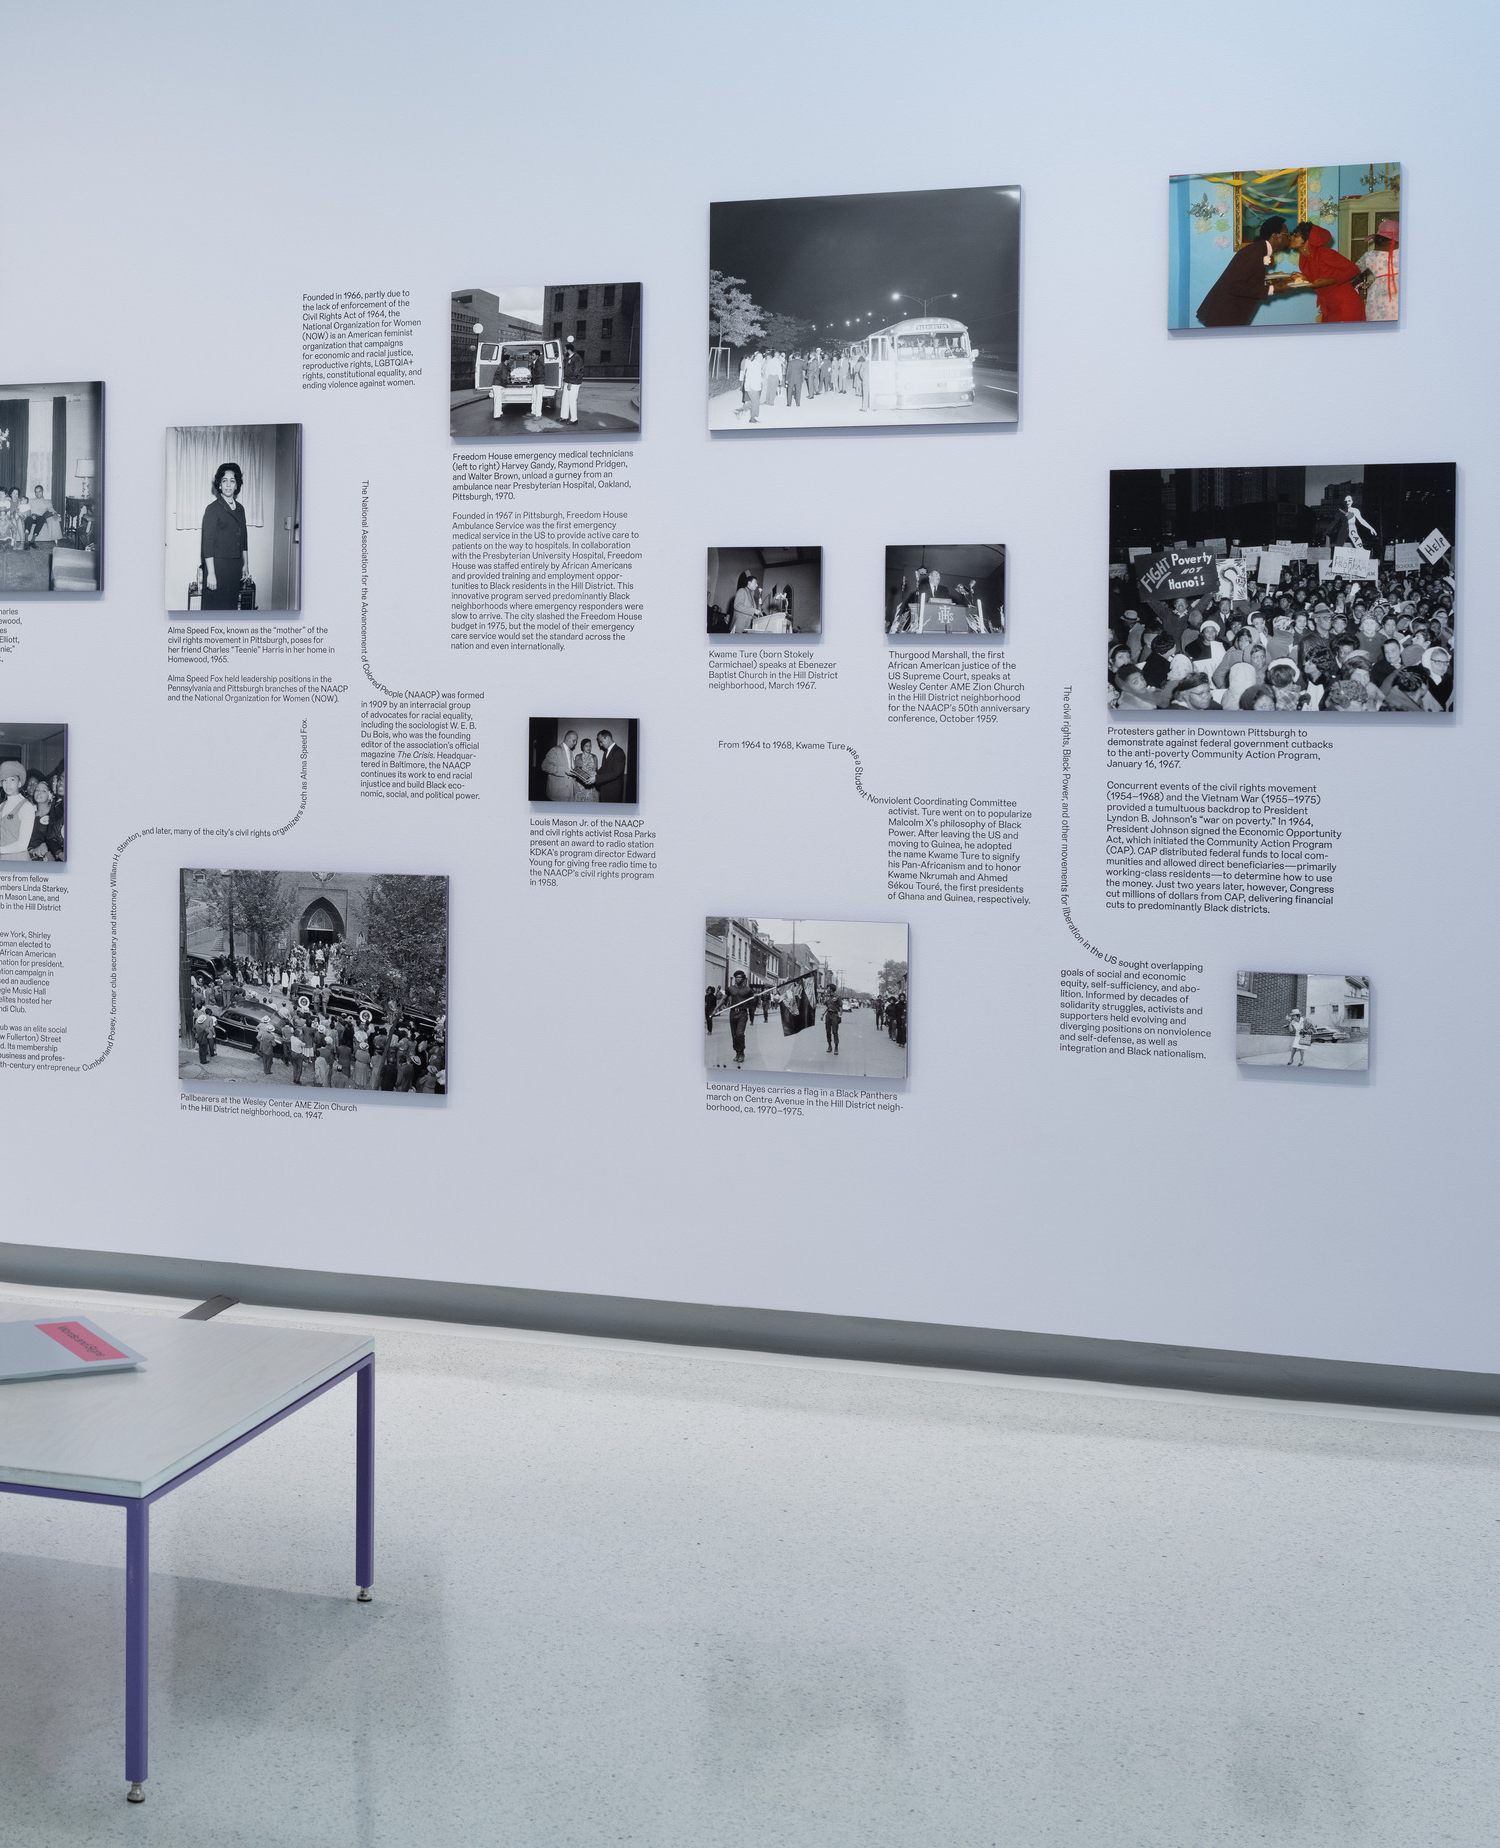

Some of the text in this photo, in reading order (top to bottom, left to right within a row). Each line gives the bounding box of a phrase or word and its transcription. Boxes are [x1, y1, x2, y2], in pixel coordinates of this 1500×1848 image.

[302, 309, 400, 322] Civil Rights Act of 1964, the
[452, 449, 633, 461] Freedom House emergency medical technicians
[1171, 552, 1212, 567] Poverty
[1140, 557, 1171, 593] FIGHT
[1168, 575, 1205, 590] Hanoi!
[708, 648, 814, 660] Kwame Ture (born Stokely
[888, 650, 1005, 660] Thurgood Marshall, the first
[708, 681, 817, 691] neighborhood, March 1967.
[1061, 685, 1072, 771] The civil rights, Black
[1107, 726, 1308, 738] Protesters gather in Downtown Pittsburgh to
[718, 740, 846, 750] From 1964 to 1968, Kwame Ture
[360, 750, 476, 761] magazine The Crisis. Headquar-
[1106, 759, 1181, 769] January 16, 1967.
[559, 850, 592, 859] program
[593, 849, 625, 858] director
[626, 849, 656, 858] Edward
[12, 874, 28, 882] from
[29, 874, 49, 883] fellow
[887, 880, 1024, 894] Sékou Touré, the first presidents
[706, 1081, 739, 1091] Leonard
[740, 1082, 766, 1095] Hayes
[767, 1085, 795, 1094] carries
[803, 1085, 819, 1098] flag
[820, 1088, 827, 1096] in
[836, 1087, 859, 1098] Black
[860, 1090, 898, 1099] Panthers
[180, 1092, 219, 1103] Pallbearers
[229, 1096, 240, 1104] the
[241, 1097, 267, 1107] Wesley
[268, 1098, 292, 1108] Center
[294, 1100, 312, 1109] AME
[313, 1101, 329, 1110] Zion
[330, 1102, 357, 1112] Church
